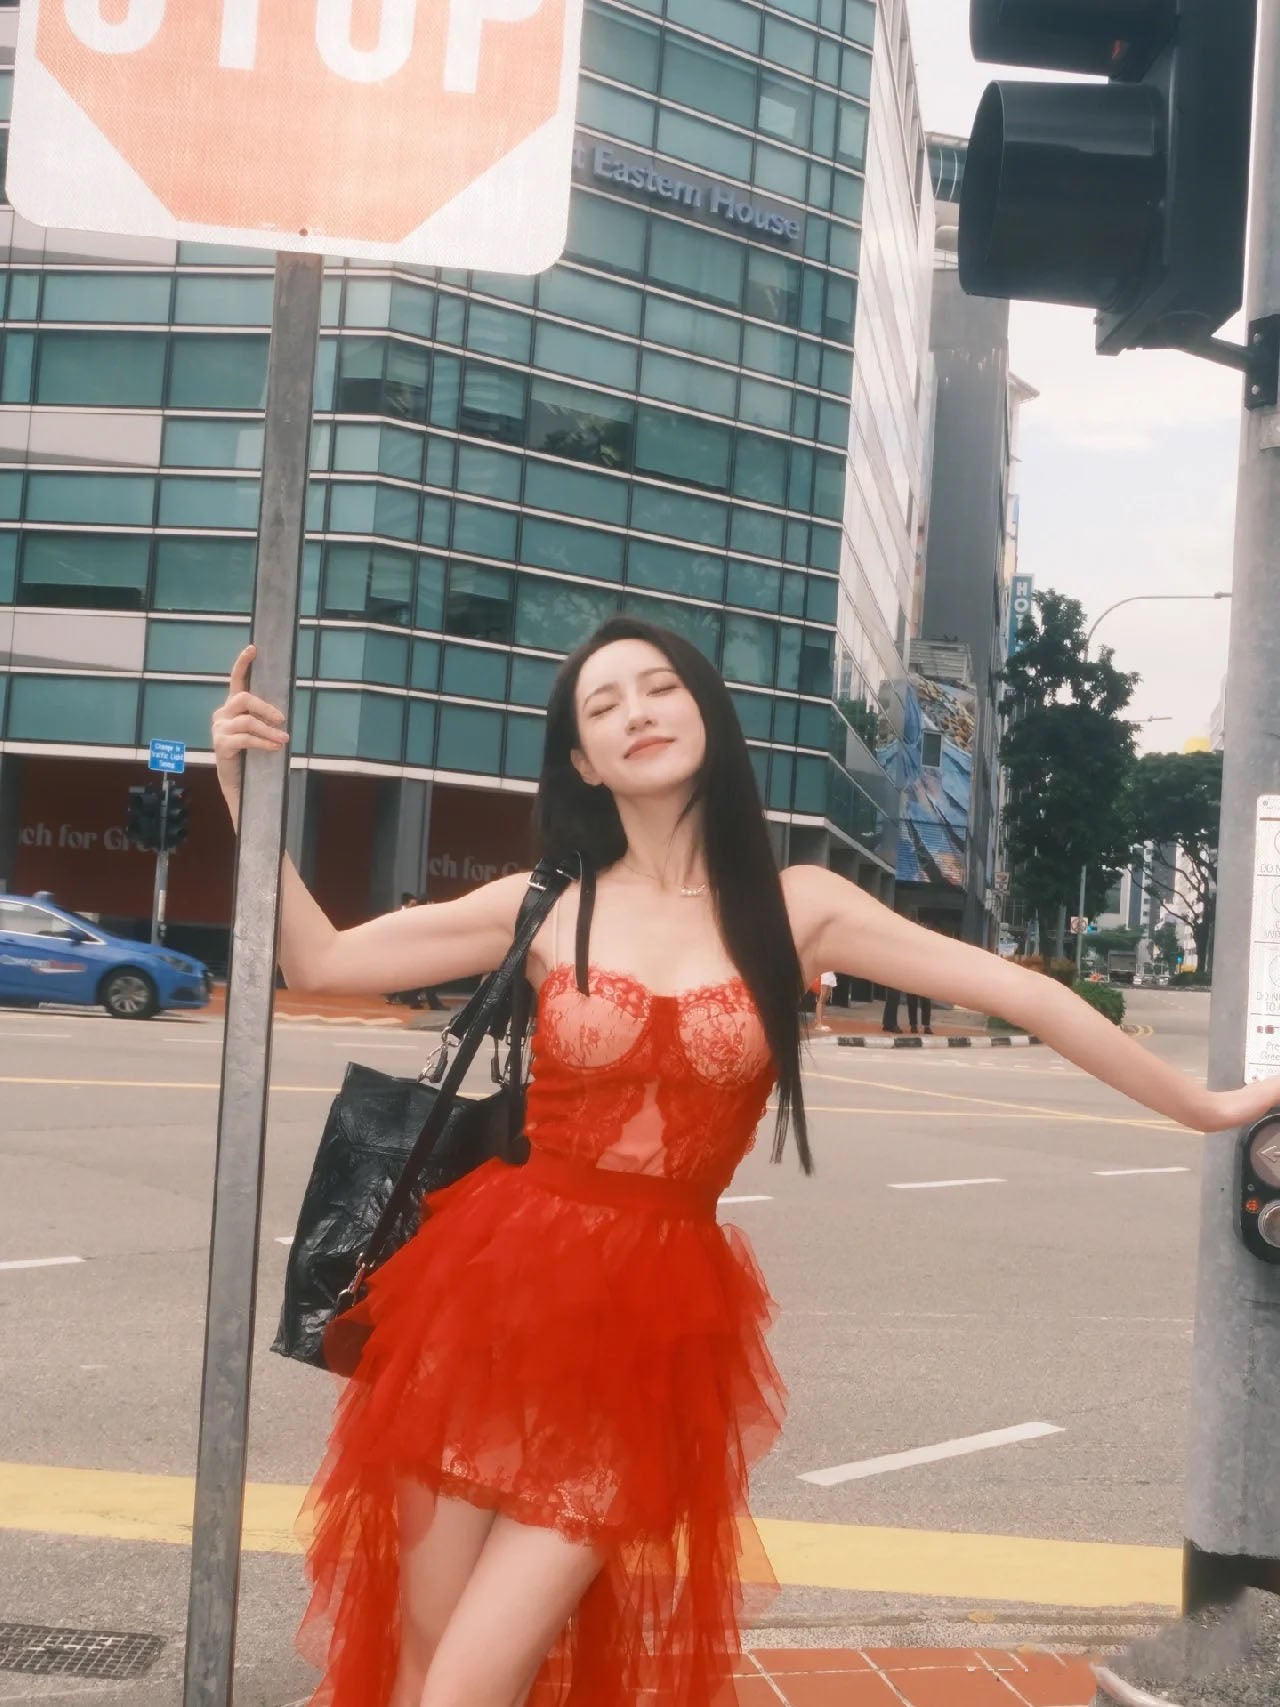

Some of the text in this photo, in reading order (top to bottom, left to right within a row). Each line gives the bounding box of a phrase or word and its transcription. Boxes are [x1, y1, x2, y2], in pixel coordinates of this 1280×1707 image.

[594, 146, 700, 208] Eastern
[709, 183, 800, 239] House
[58, 823, 97, 849] for
[463, 855, 497, 881] for
